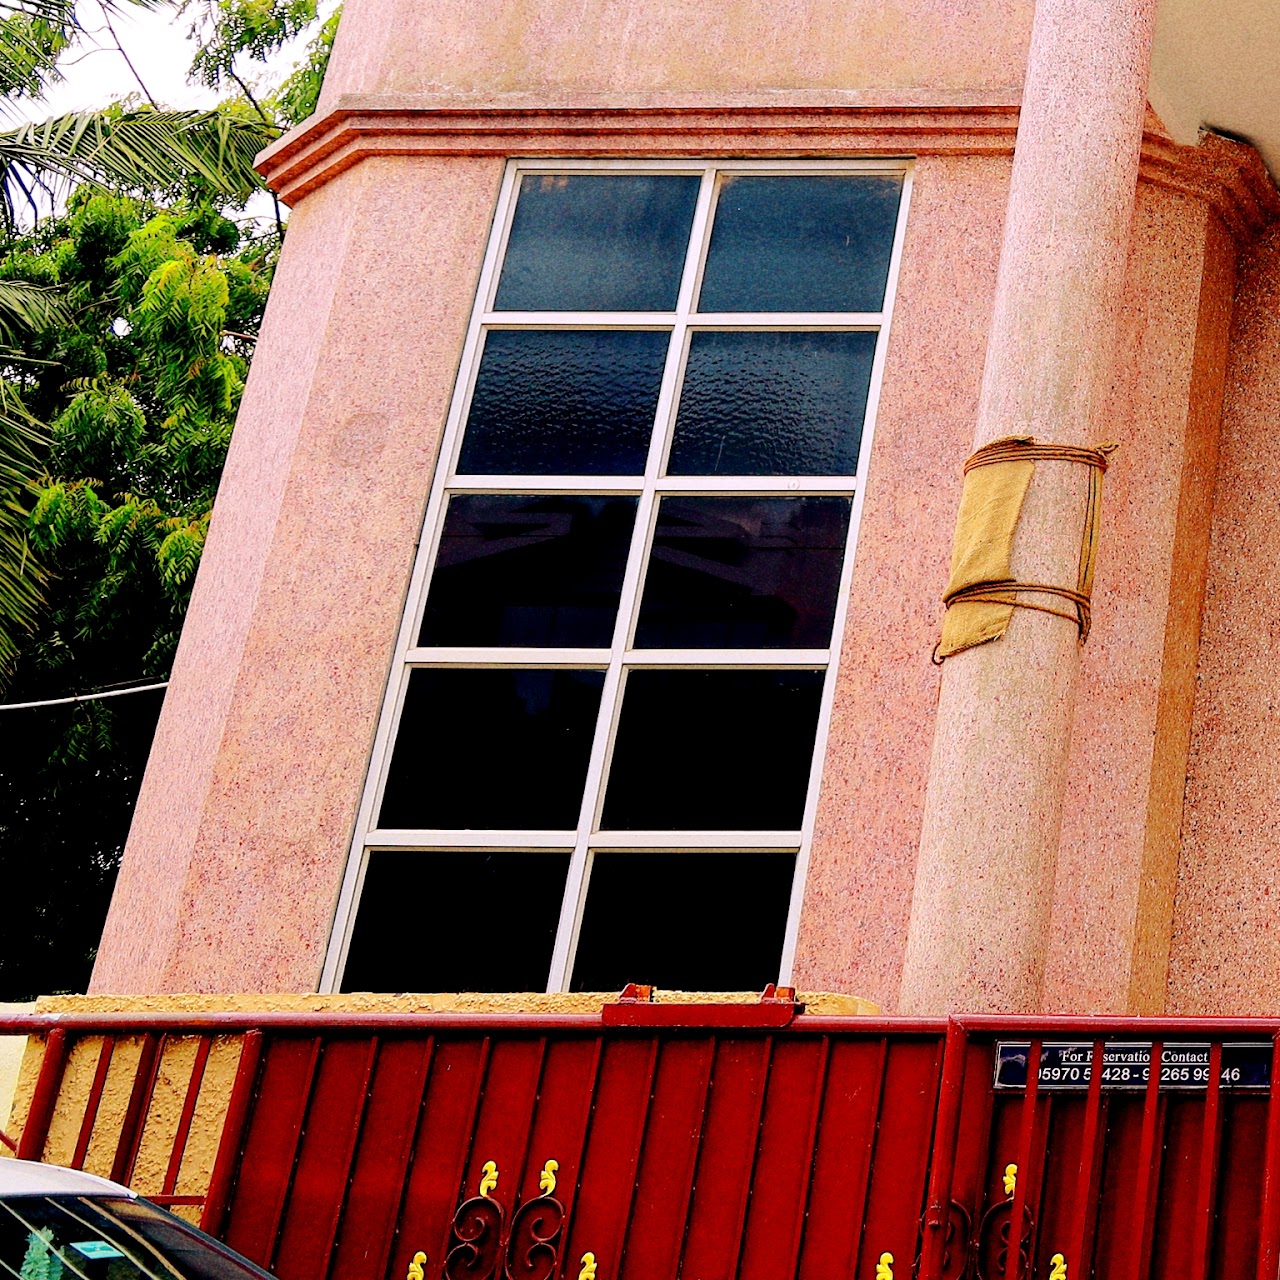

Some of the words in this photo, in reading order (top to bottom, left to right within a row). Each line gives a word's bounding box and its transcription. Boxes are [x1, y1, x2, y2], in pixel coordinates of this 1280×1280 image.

[1062, 1050, 1083, 1062] For
[1161, 1051, 1208, 1062] Contact
[1037, 1068, 1080, 1080] 5970
[1083, 1068, 1131, 1080] 5428
[1141, 1068, 1190, 1080] 9265
[1193, 1068, 1240, 1080] 9946
